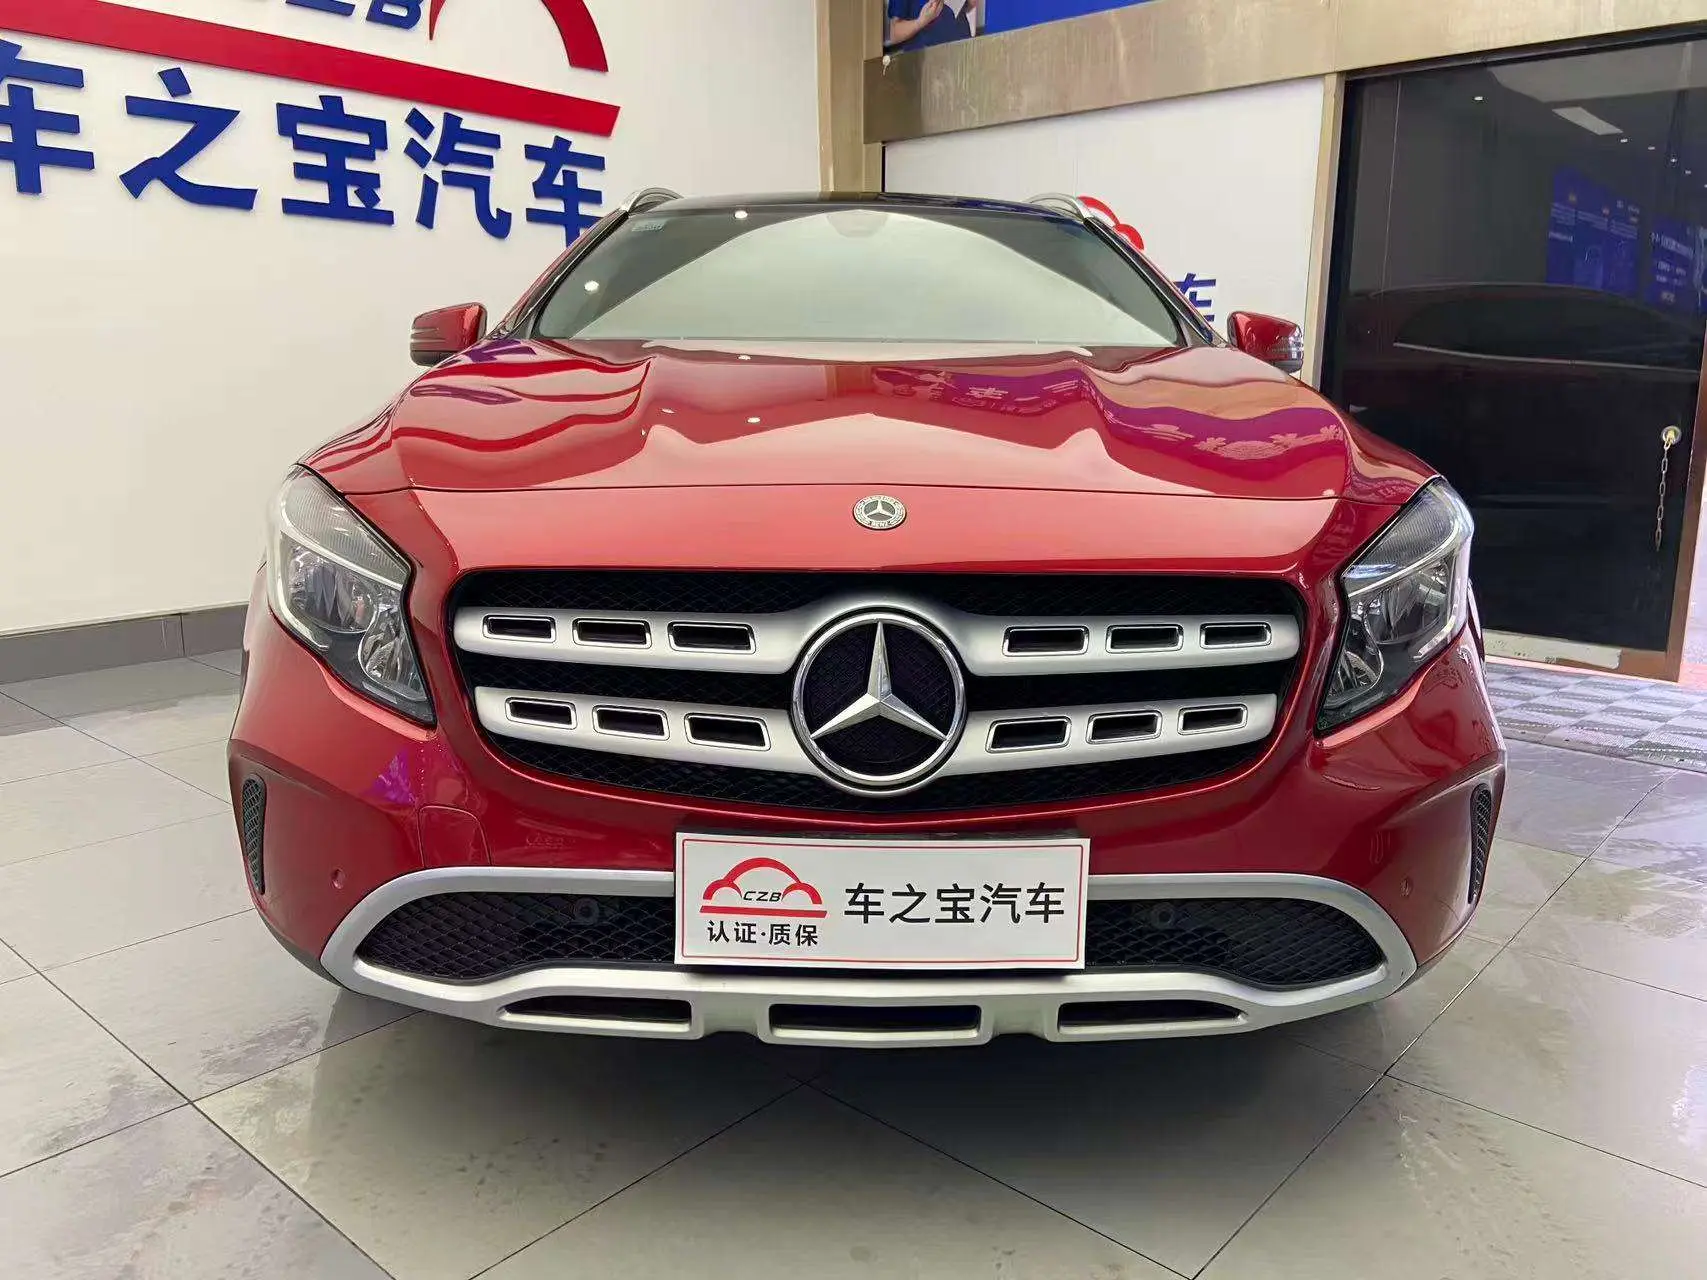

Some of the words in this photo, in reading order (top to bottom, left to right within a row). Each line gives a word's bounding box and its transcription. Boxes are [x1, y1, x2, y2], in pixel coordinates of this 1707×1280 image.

[0, 39, 606, 247] 车之宝汽车
[743, 890, 783, 902] CZB
[844, 882, 1065, 924] 车之宝汽车
[707, 921, 818, 947] 认证·质保
